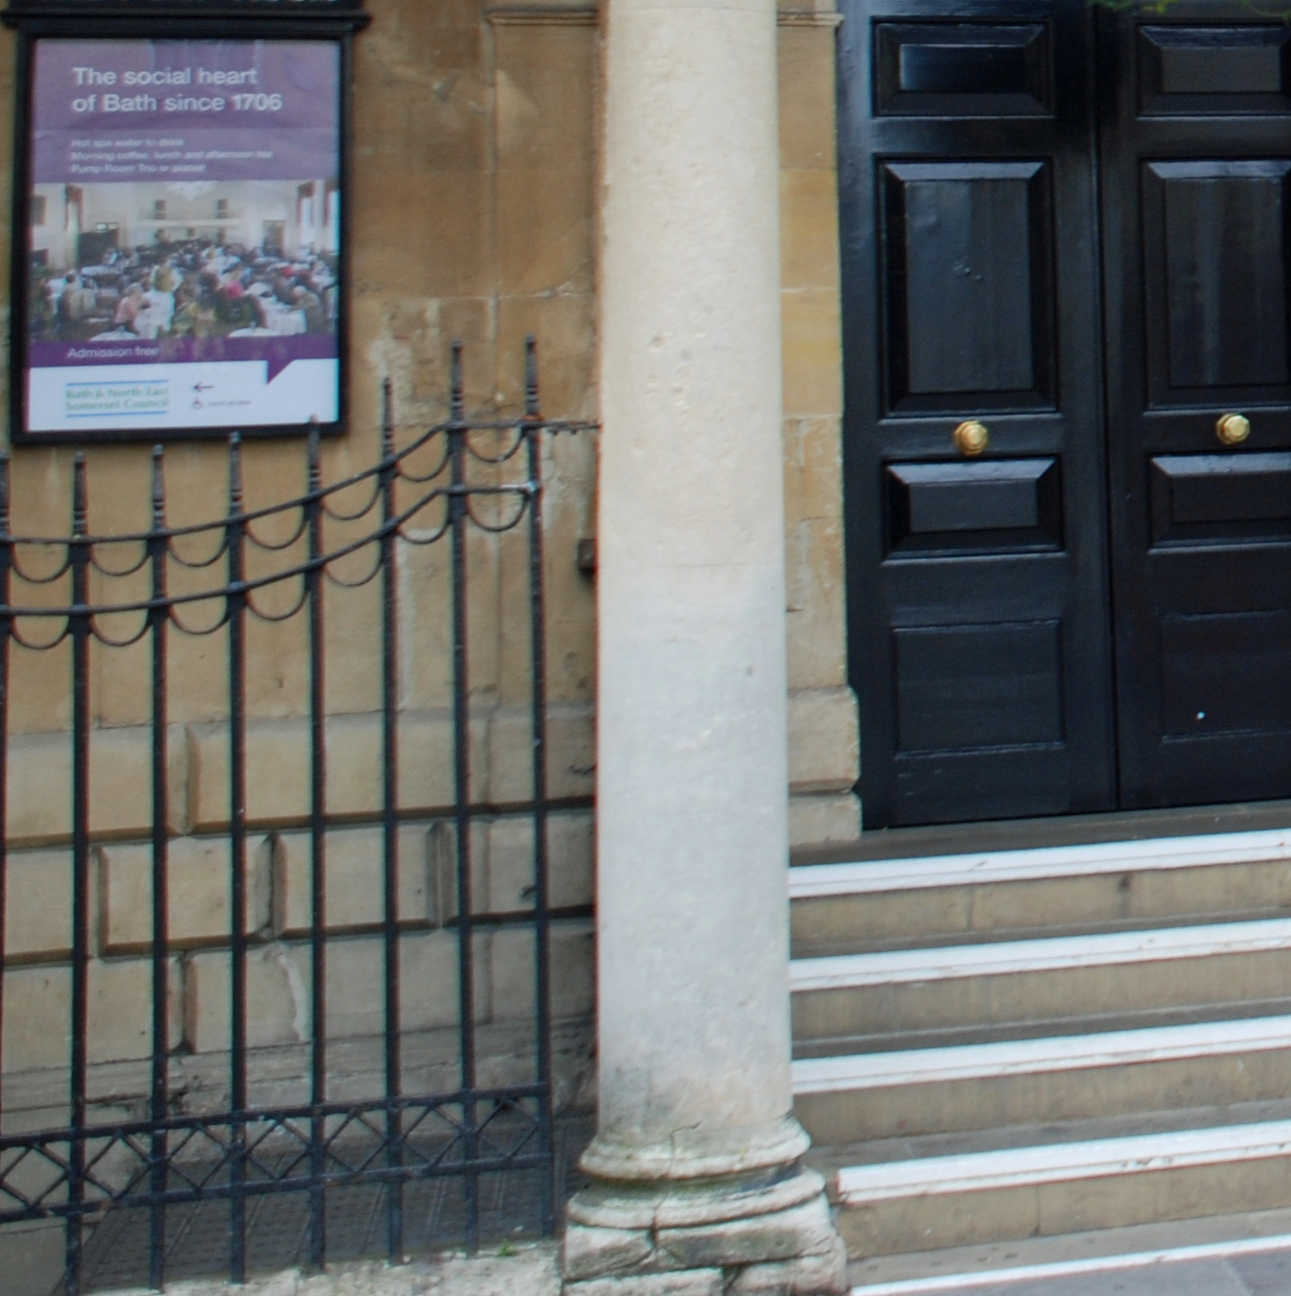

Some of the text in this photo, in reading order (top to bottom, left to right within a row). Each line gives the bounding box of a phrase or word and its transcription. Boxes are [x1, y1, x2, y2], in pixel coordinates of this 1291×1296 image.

[73, 67, 258, 85] The social heart
[72, 93, 283, 112] of Bath since 1706
[68, 346, 160, 359] Admission free
